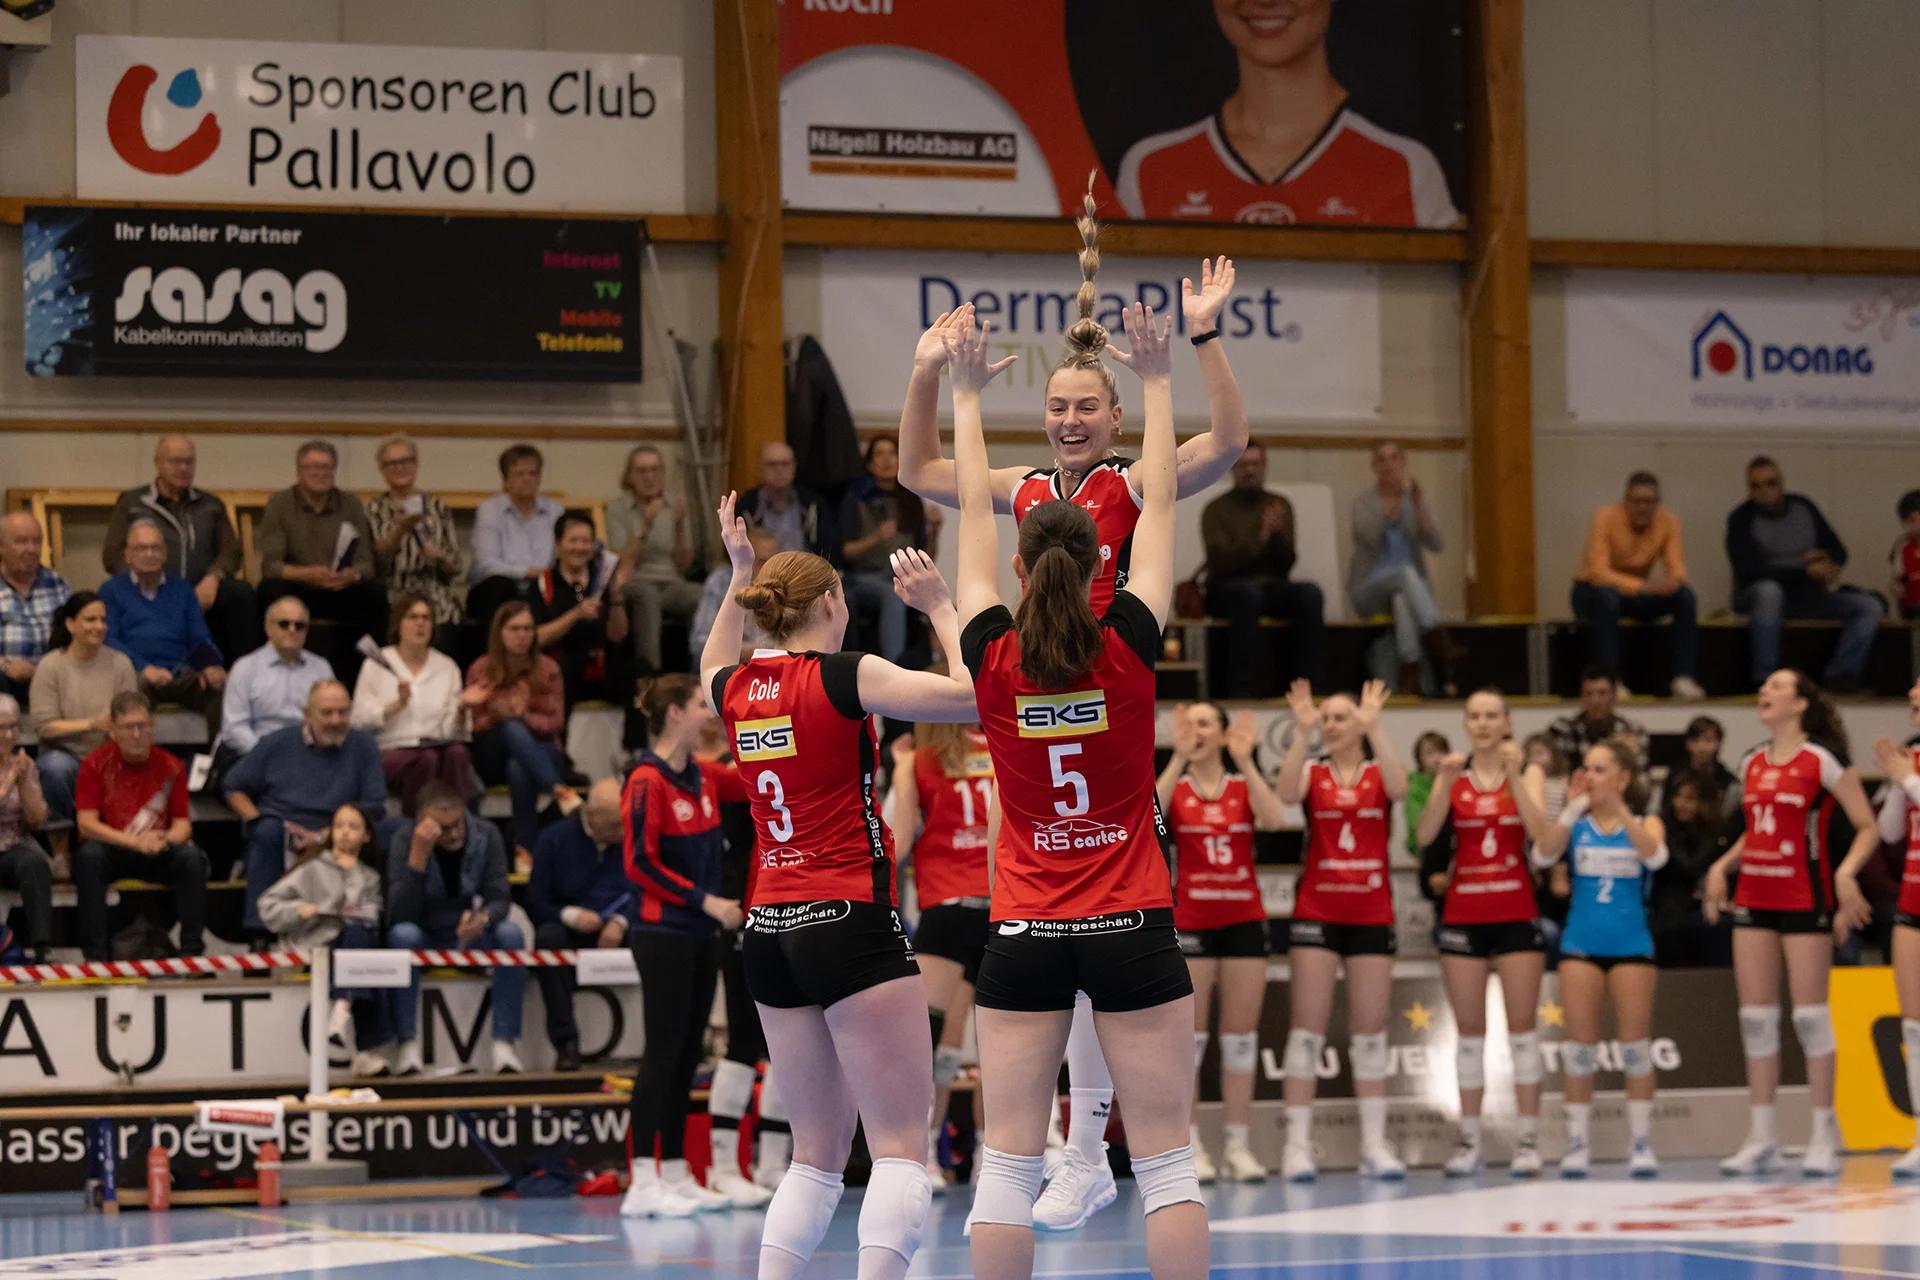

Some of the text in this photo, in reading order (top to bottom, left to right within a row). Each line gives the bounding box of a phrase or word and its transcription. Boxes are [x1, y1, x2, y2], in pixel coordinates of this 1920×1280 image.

[248, 61, 656, 121] Sponsoren Club
[811, 128, 1015, 157] Nägeli Holzbau AG
[248, 127, 536, 194] Pallavolo
[115, 222, 302, 244] Ihr lokaler Partner
[543, 252, 621, 269] Internet
[593, 281, 622, 298] TV
[115, 265, 348, 352] sasag
[560, 310, 623, 327] Mobile
[920, 276, 1282, 338] DermaPlst
[114, 326, 304, 347] Kabelkommunikation
[536, 332, 624, 352] Telefonie
[1763, 345, 1874, 374] DONAG
[748, 676, 781, 701] Cole
[1017, 700, 1105, 727] EKS
[736, 726, 793, 751] EKS
[1047, 742, 1090, 817] 5
[757, 769, 794, 842] 3
[1752, 803, 1777, 836] 14
[1034, 829, 1128, 851] RS cartec
[1203, 835, 1233, 865] 15
[1030, 917, 1133, 932] Malergeschäft
[1030, 930, 1060, 938] GmbH
